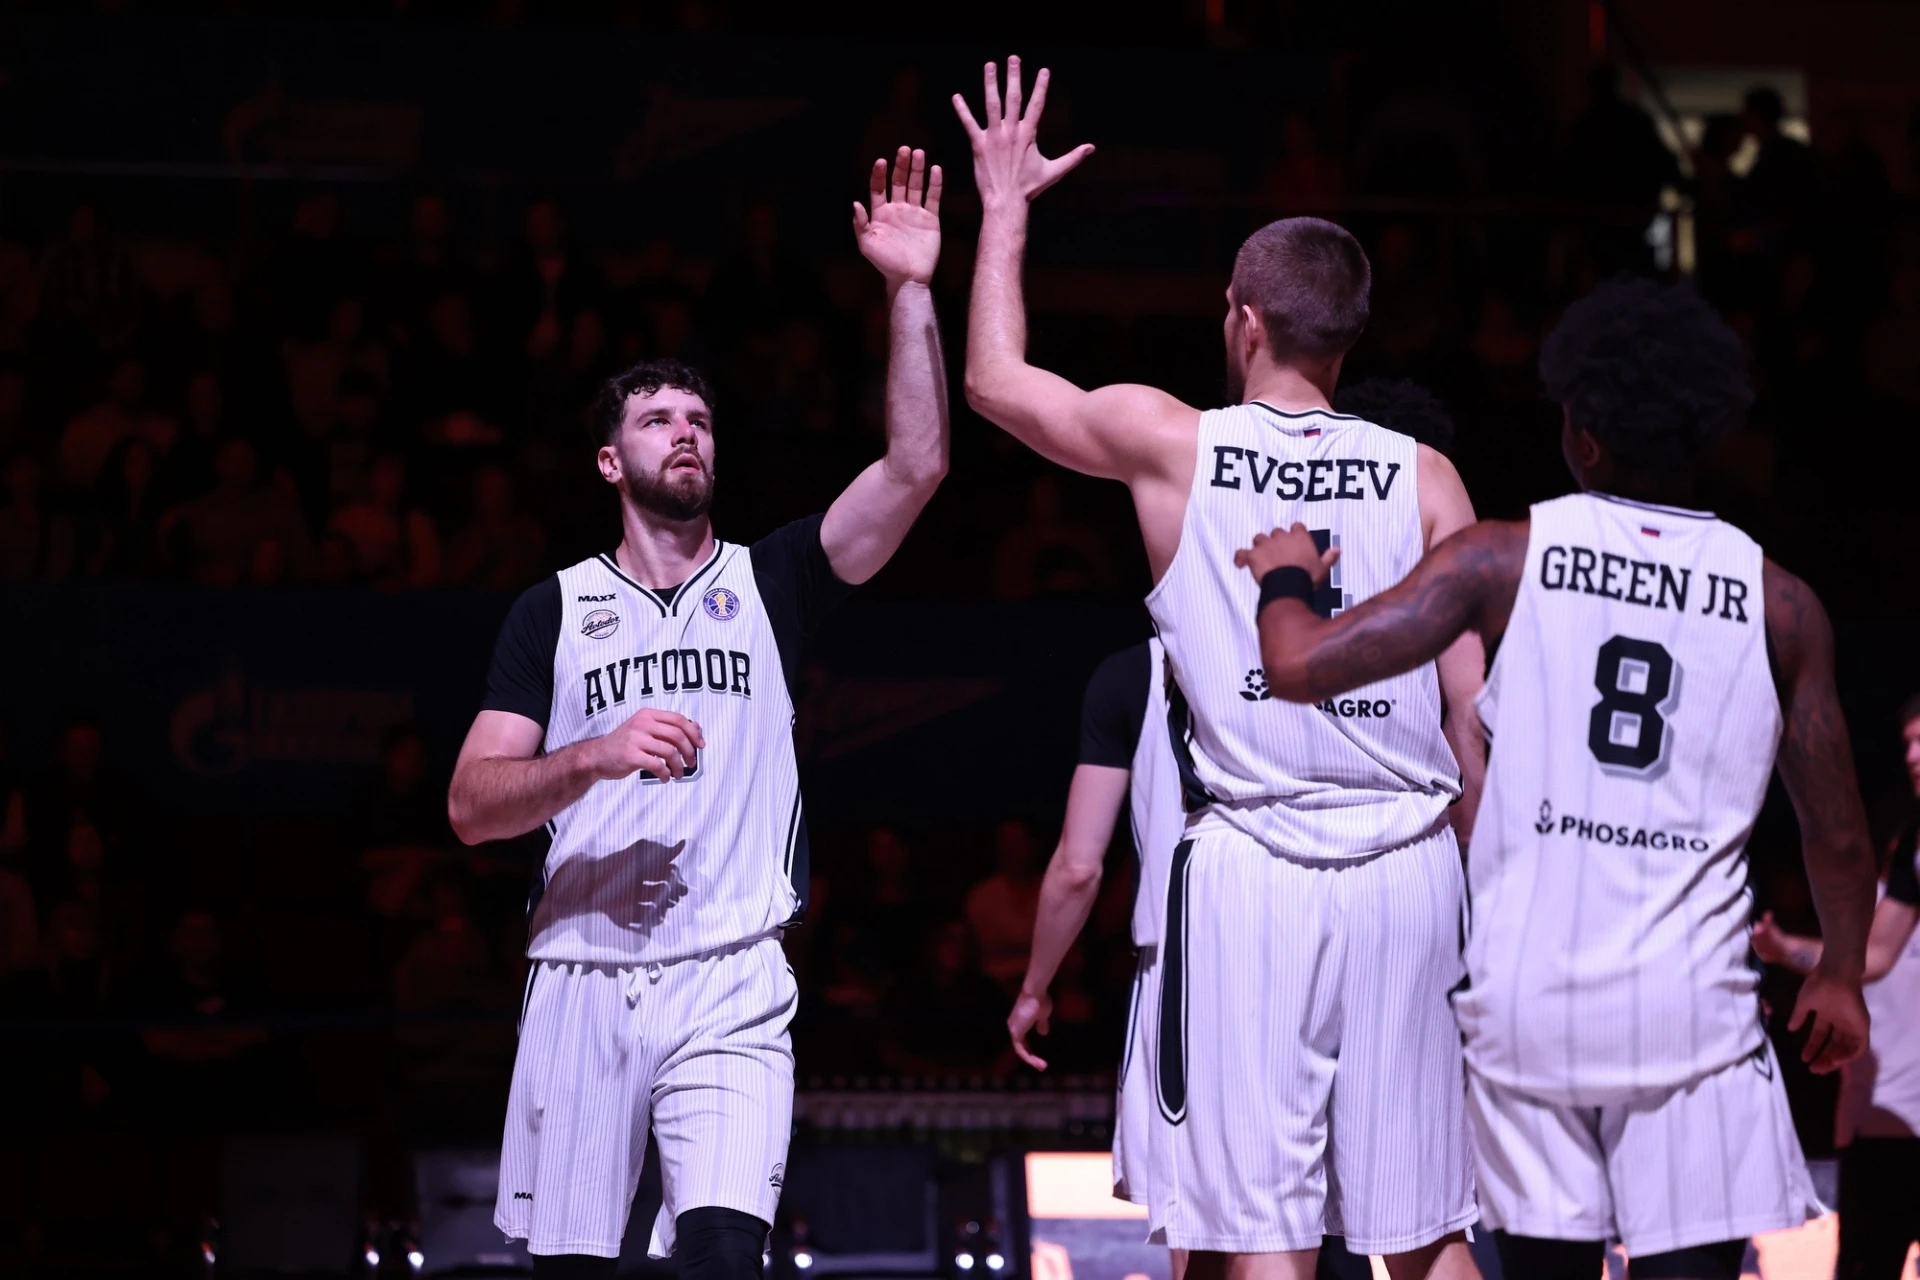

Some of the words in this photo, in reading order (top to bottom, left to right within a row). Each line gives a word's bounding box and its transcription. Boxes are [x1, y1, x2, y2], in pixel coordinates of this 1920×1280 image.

[1210, 445, 1401, 502] EVSEEV
[577, 593, 617, 602] MAXX
[1541, 545, 1692, 612] GREEN
[1701, 573, 1748, 623] JR
[583, 648, 751, 719] AVTODOR
[1314, 699, 1391, 718] AGRO
[1588, 634, 1682, 781] 8
[1560, 815, 1709, 852] PHOSAGRO
[514, 1192, 533, 1201] MA
